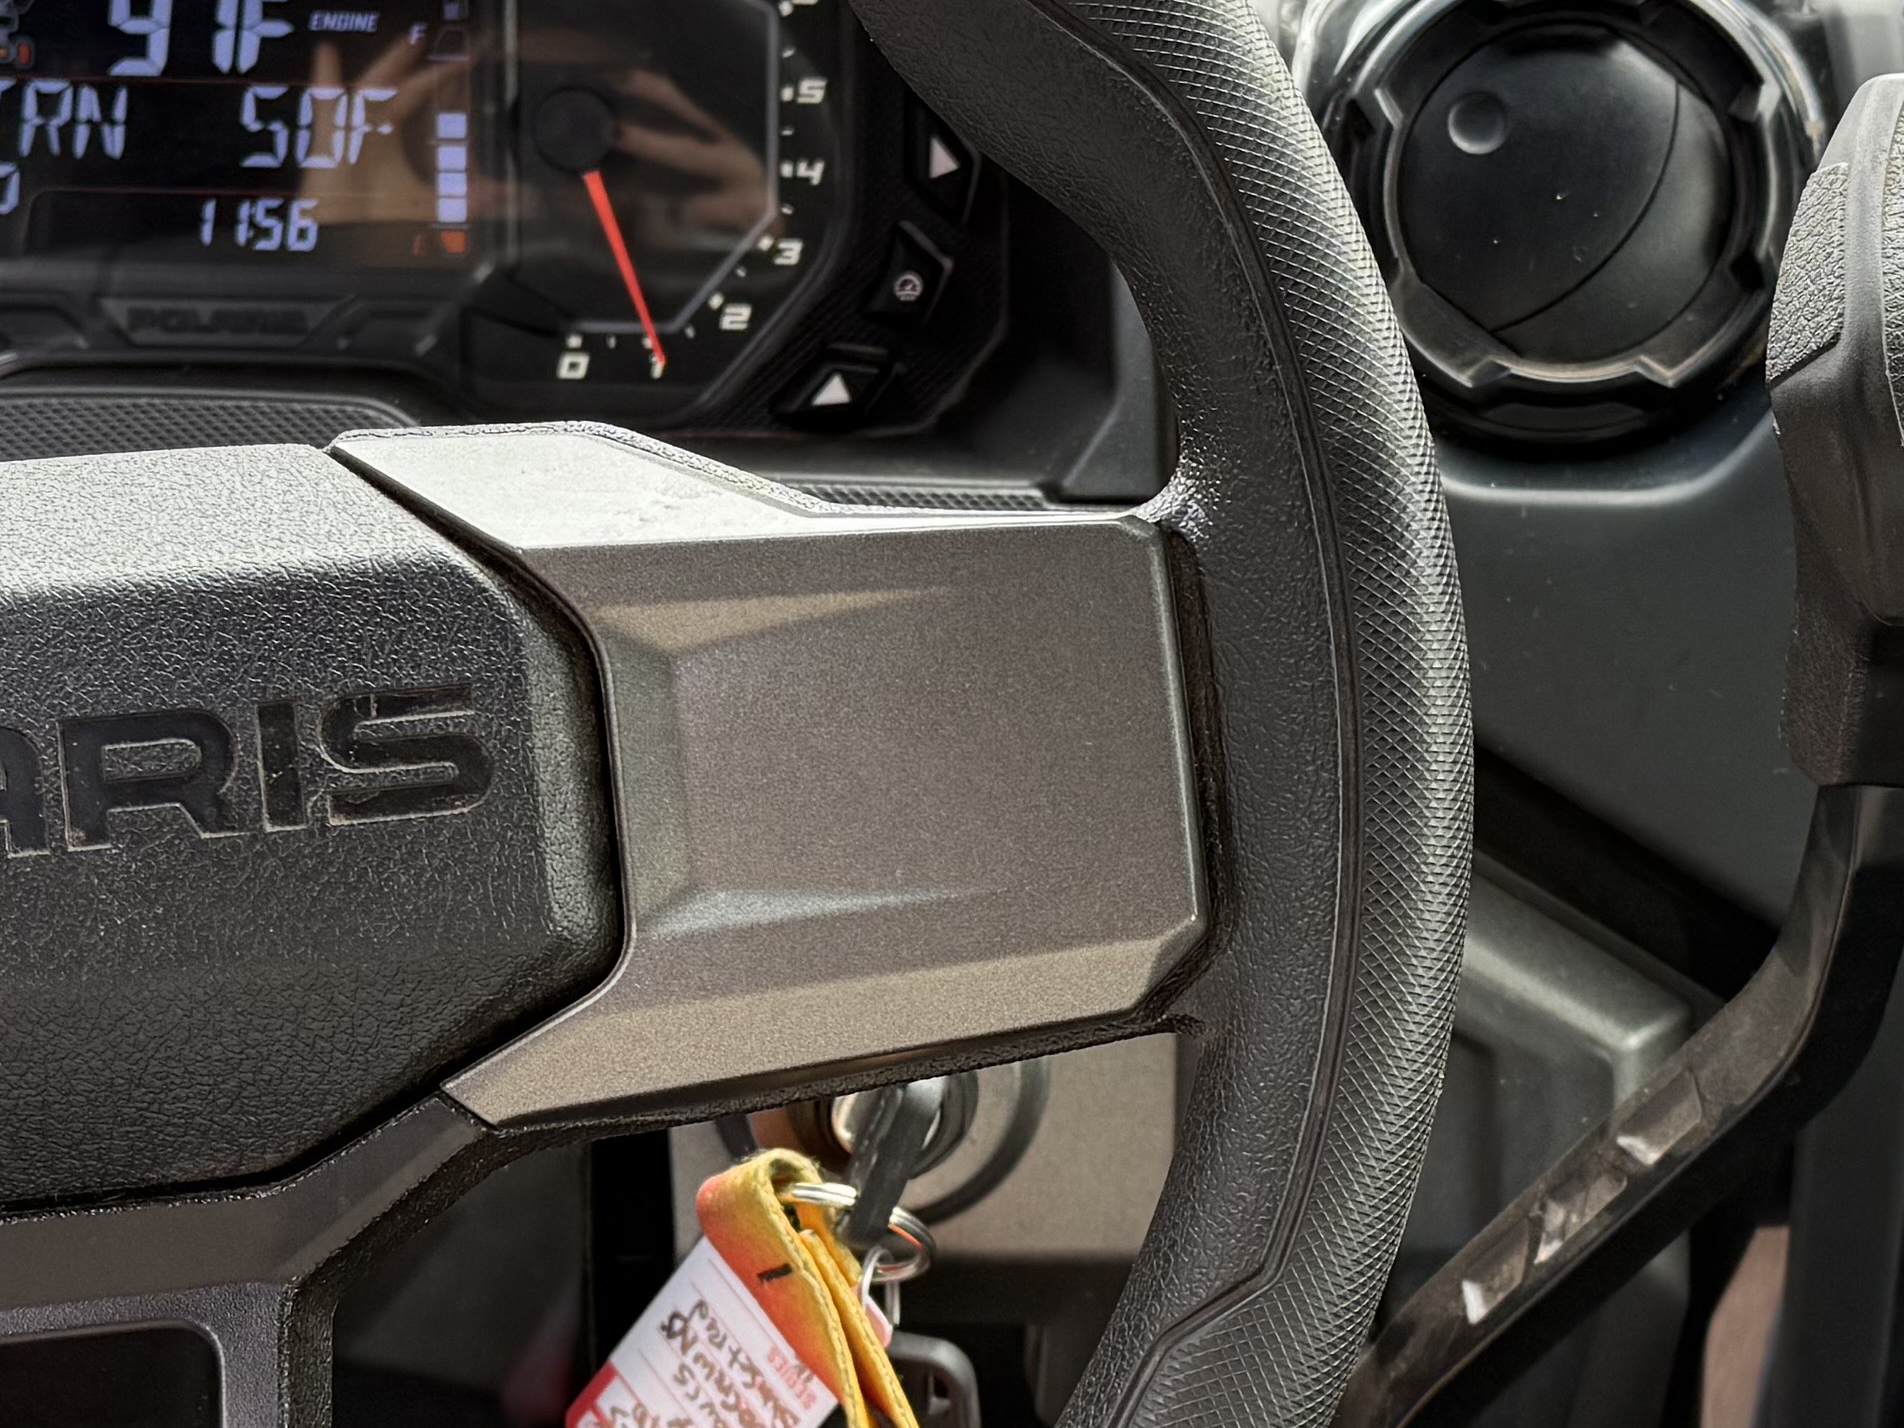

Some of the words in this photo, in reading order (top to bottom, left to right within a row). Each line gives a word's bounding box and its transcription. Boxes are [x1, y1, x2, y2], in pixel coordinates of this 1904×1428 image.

[308, 12, 379, 32] ENGINE
[409, 23, 427, 44] F
[797, 77, 828, 104] 5
[796, 159, 825, 186] 4
[773, 238, 803, 266] 3
[720, 303, 752, 331] 2
[557, 352, 590, 380] 0
